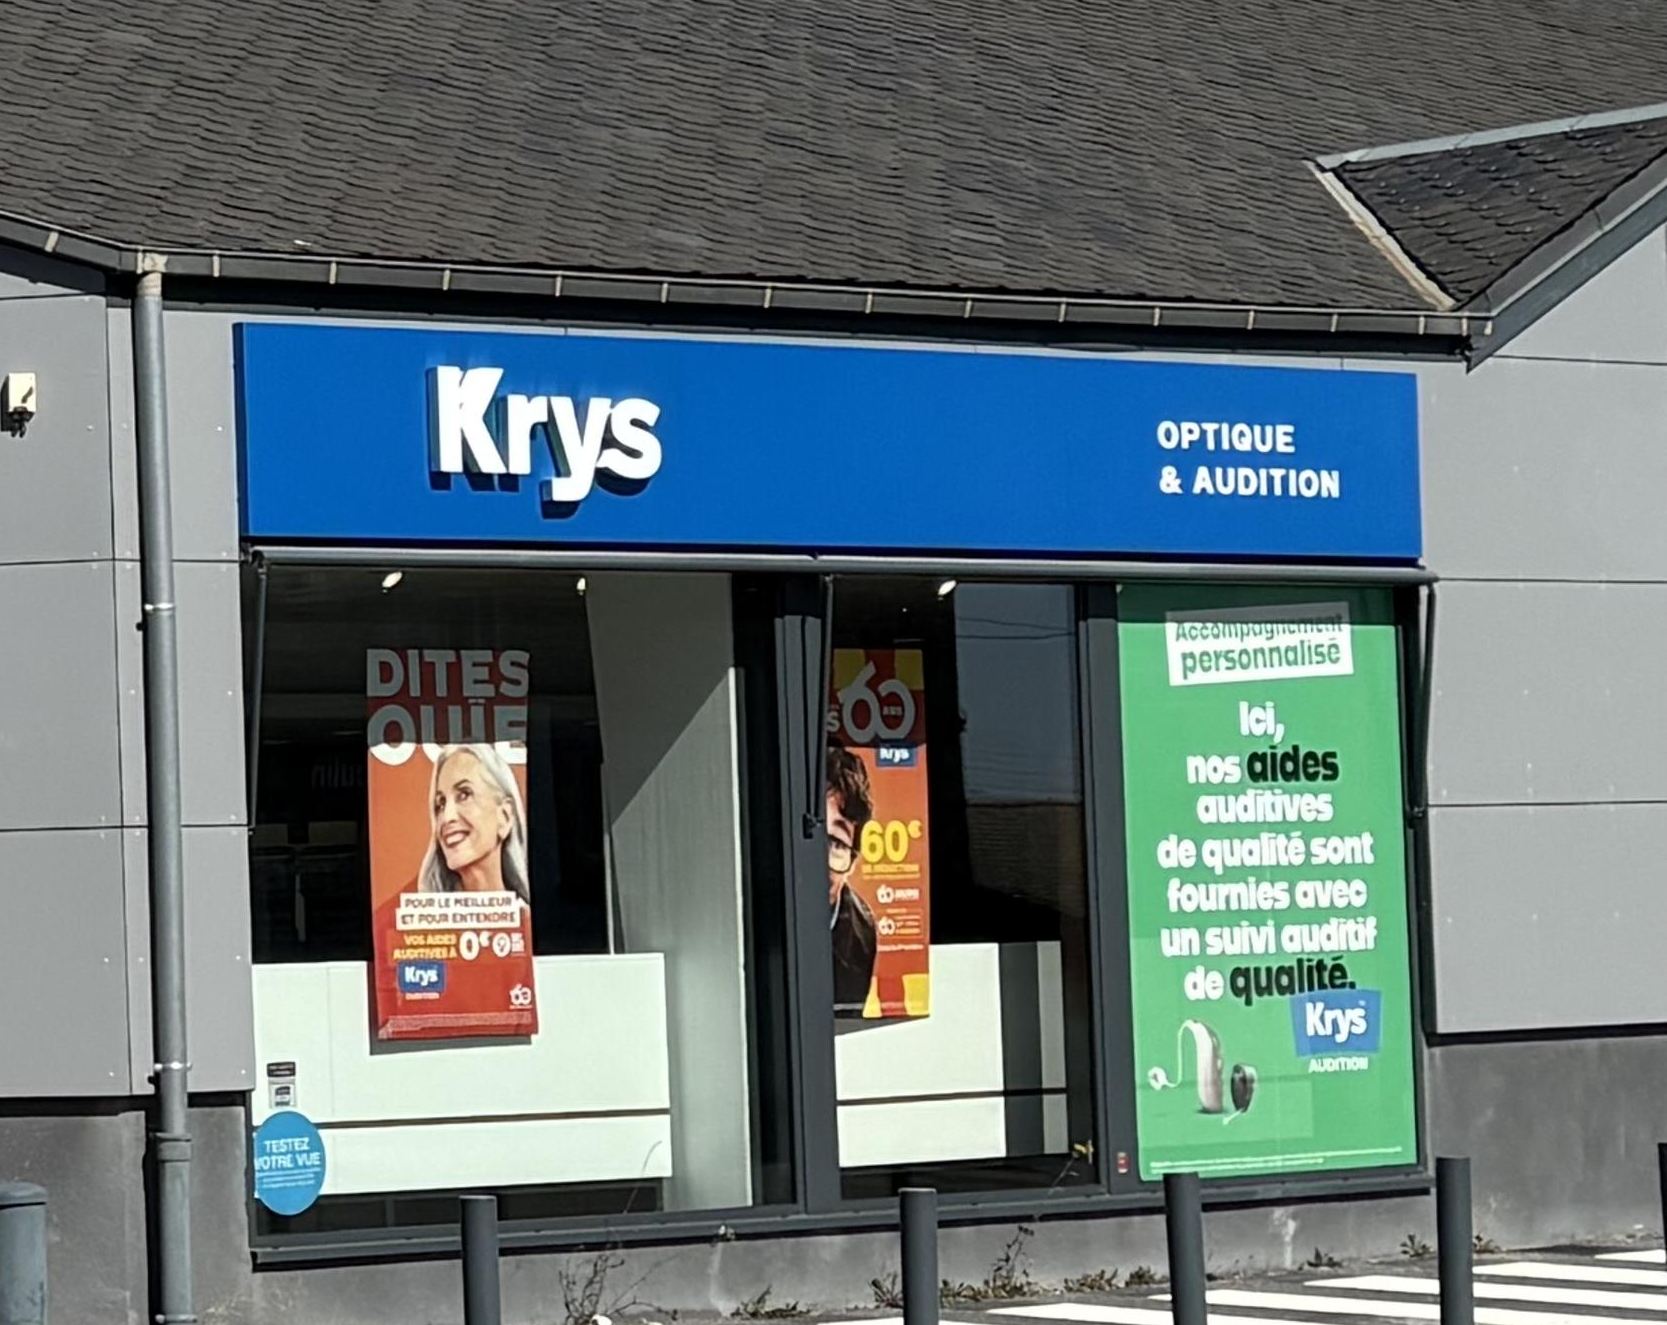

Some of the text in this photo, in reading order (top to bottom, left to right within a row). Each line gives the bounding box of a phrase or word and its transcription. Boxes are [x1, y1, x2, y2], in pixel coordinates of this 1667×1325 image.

[435, 364, 663, 503] Krys
[1156, 420, 1296, 453] OPTIQUE
[1159, 465, 1341, 499] & AUDITION
[1175, 612, 1344, 643] Accompagnement
[366, 648, 531, 698] DITES
[1180, 637, 1342, 680] personnalisé
[1238, 700, 1286, 745] Ici,
[1186, 744, 1340, 785] nos aides
[1196, 788, 1334, 824] auditives
[1156, 830, 1375, 876] de qualité sont
[404, 896, 512, 909] POUR LE MEILLEUR
[1167, 876, 1368, 913] fournies avec
[401, 911, 516, 925] ET POUR ENTENDRE
[1160, 915, 1378, 957] un suivi auditif
[404, 966, 439, 986] Krys
[1183, 954, 1357, 1007] de qualité.
[1305, 1000, 1368, 1044] Krys
[1308, 1056, 1369, 1073] AUDITION
[262, 1136, 310, 1154] TESTEZ
[296, 1151, 321, 1166] VUE
